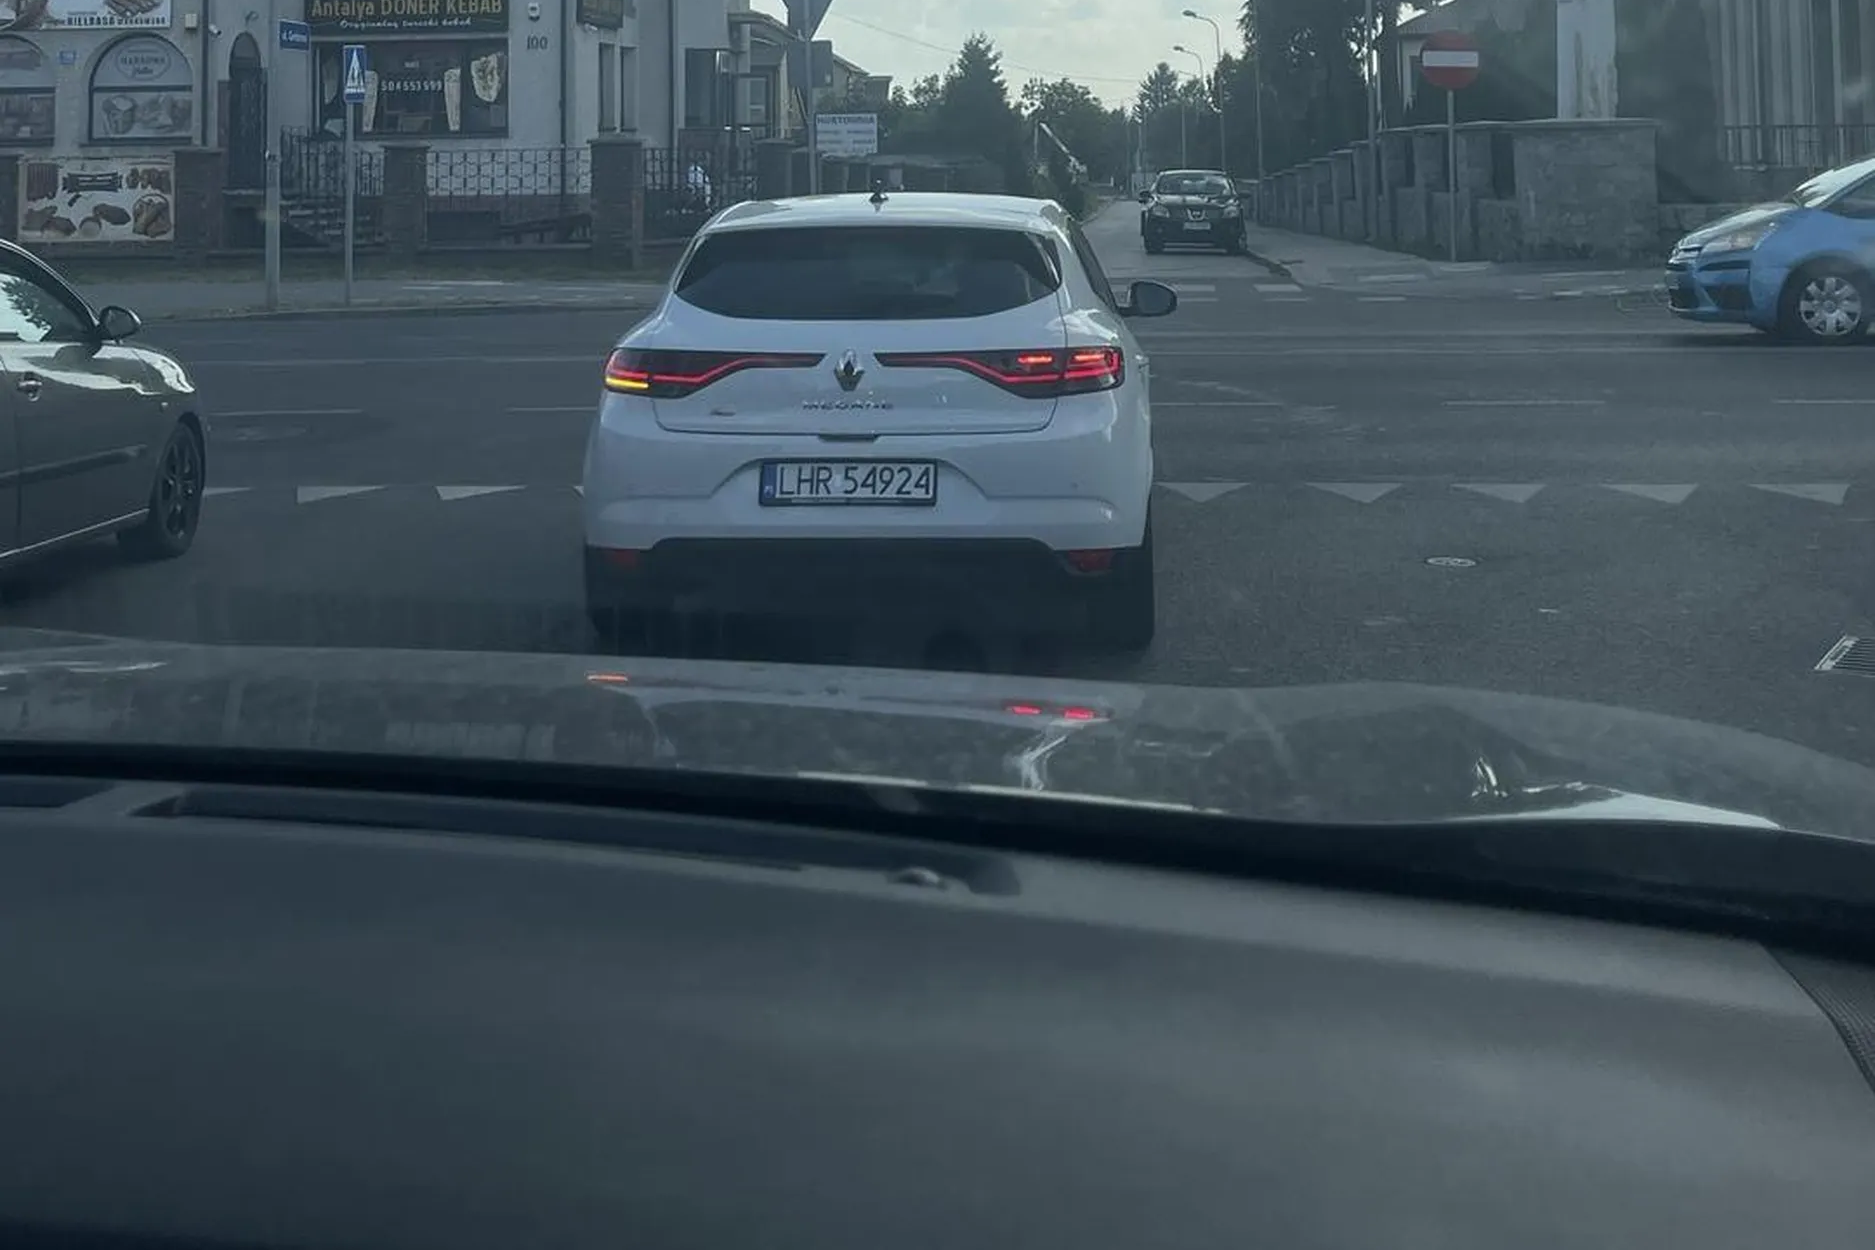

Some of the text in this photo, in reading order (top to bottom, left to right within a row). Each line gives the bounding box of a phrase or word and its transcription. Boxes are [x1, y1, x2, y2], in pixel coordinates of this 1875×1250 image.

[526, 34, 549, 50] 100
[778, 466, 931, 496] LHR 54924
